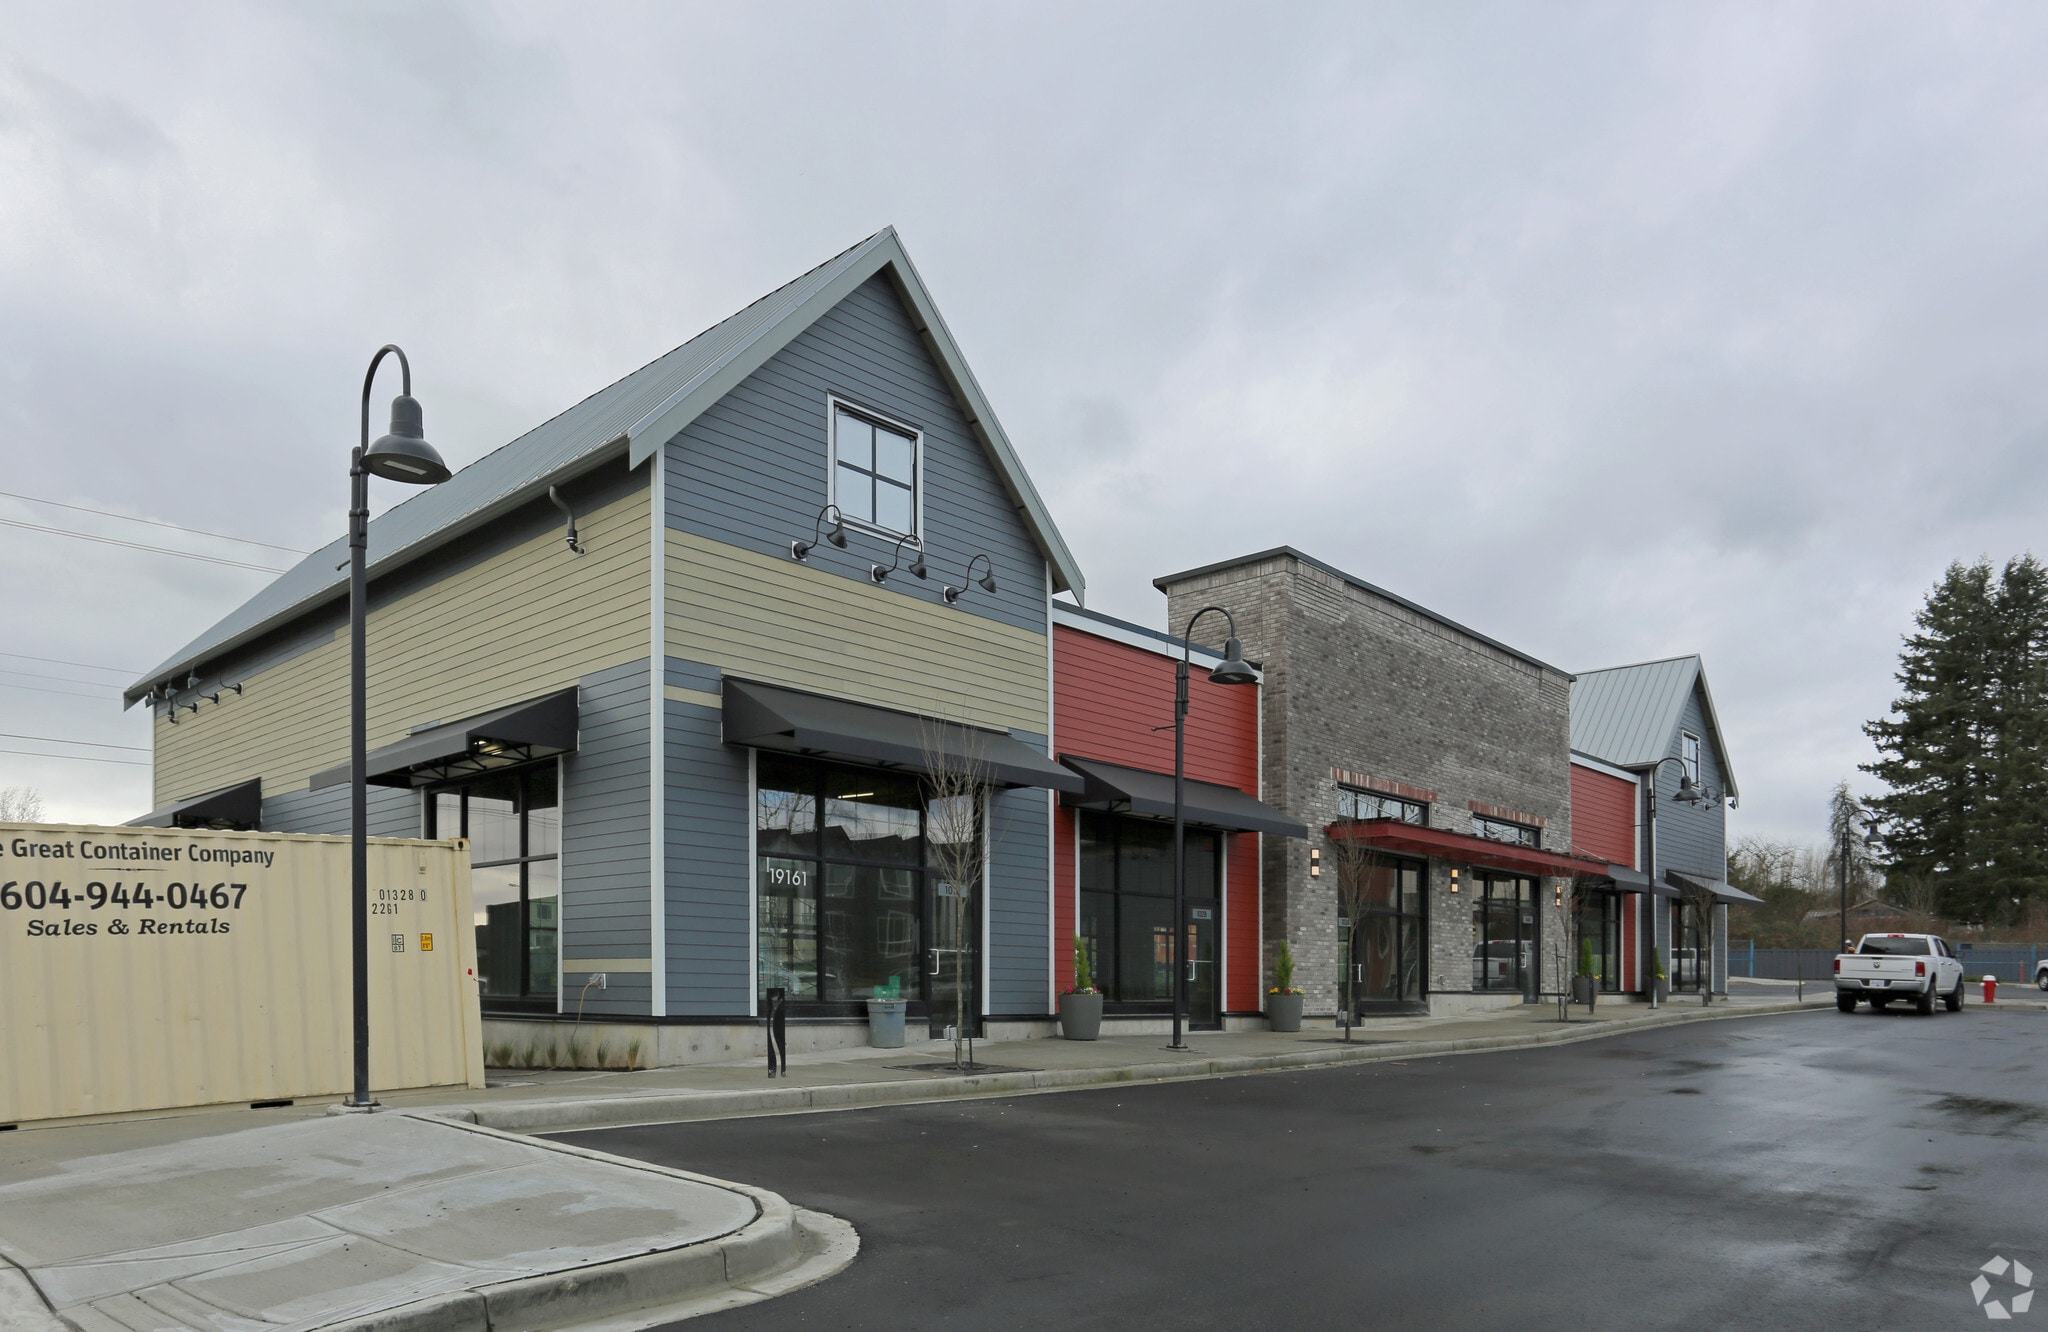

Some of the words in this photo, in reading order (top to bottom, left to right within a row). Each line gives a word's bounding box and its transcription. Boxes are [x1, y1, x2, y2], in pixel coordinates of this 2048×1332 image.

[11, 838, 75, 859] Great
[80, 840, 182, 861] Container
[188, 843, 275, 869] Company
[769, 868, 807, 887] 19161
[0, 880, 248, 911] 604-944-0467
[27, 918, 98, 937] Sales
[107, 918, 130, 936] &
[137, 917, 230, 935] Rentals
